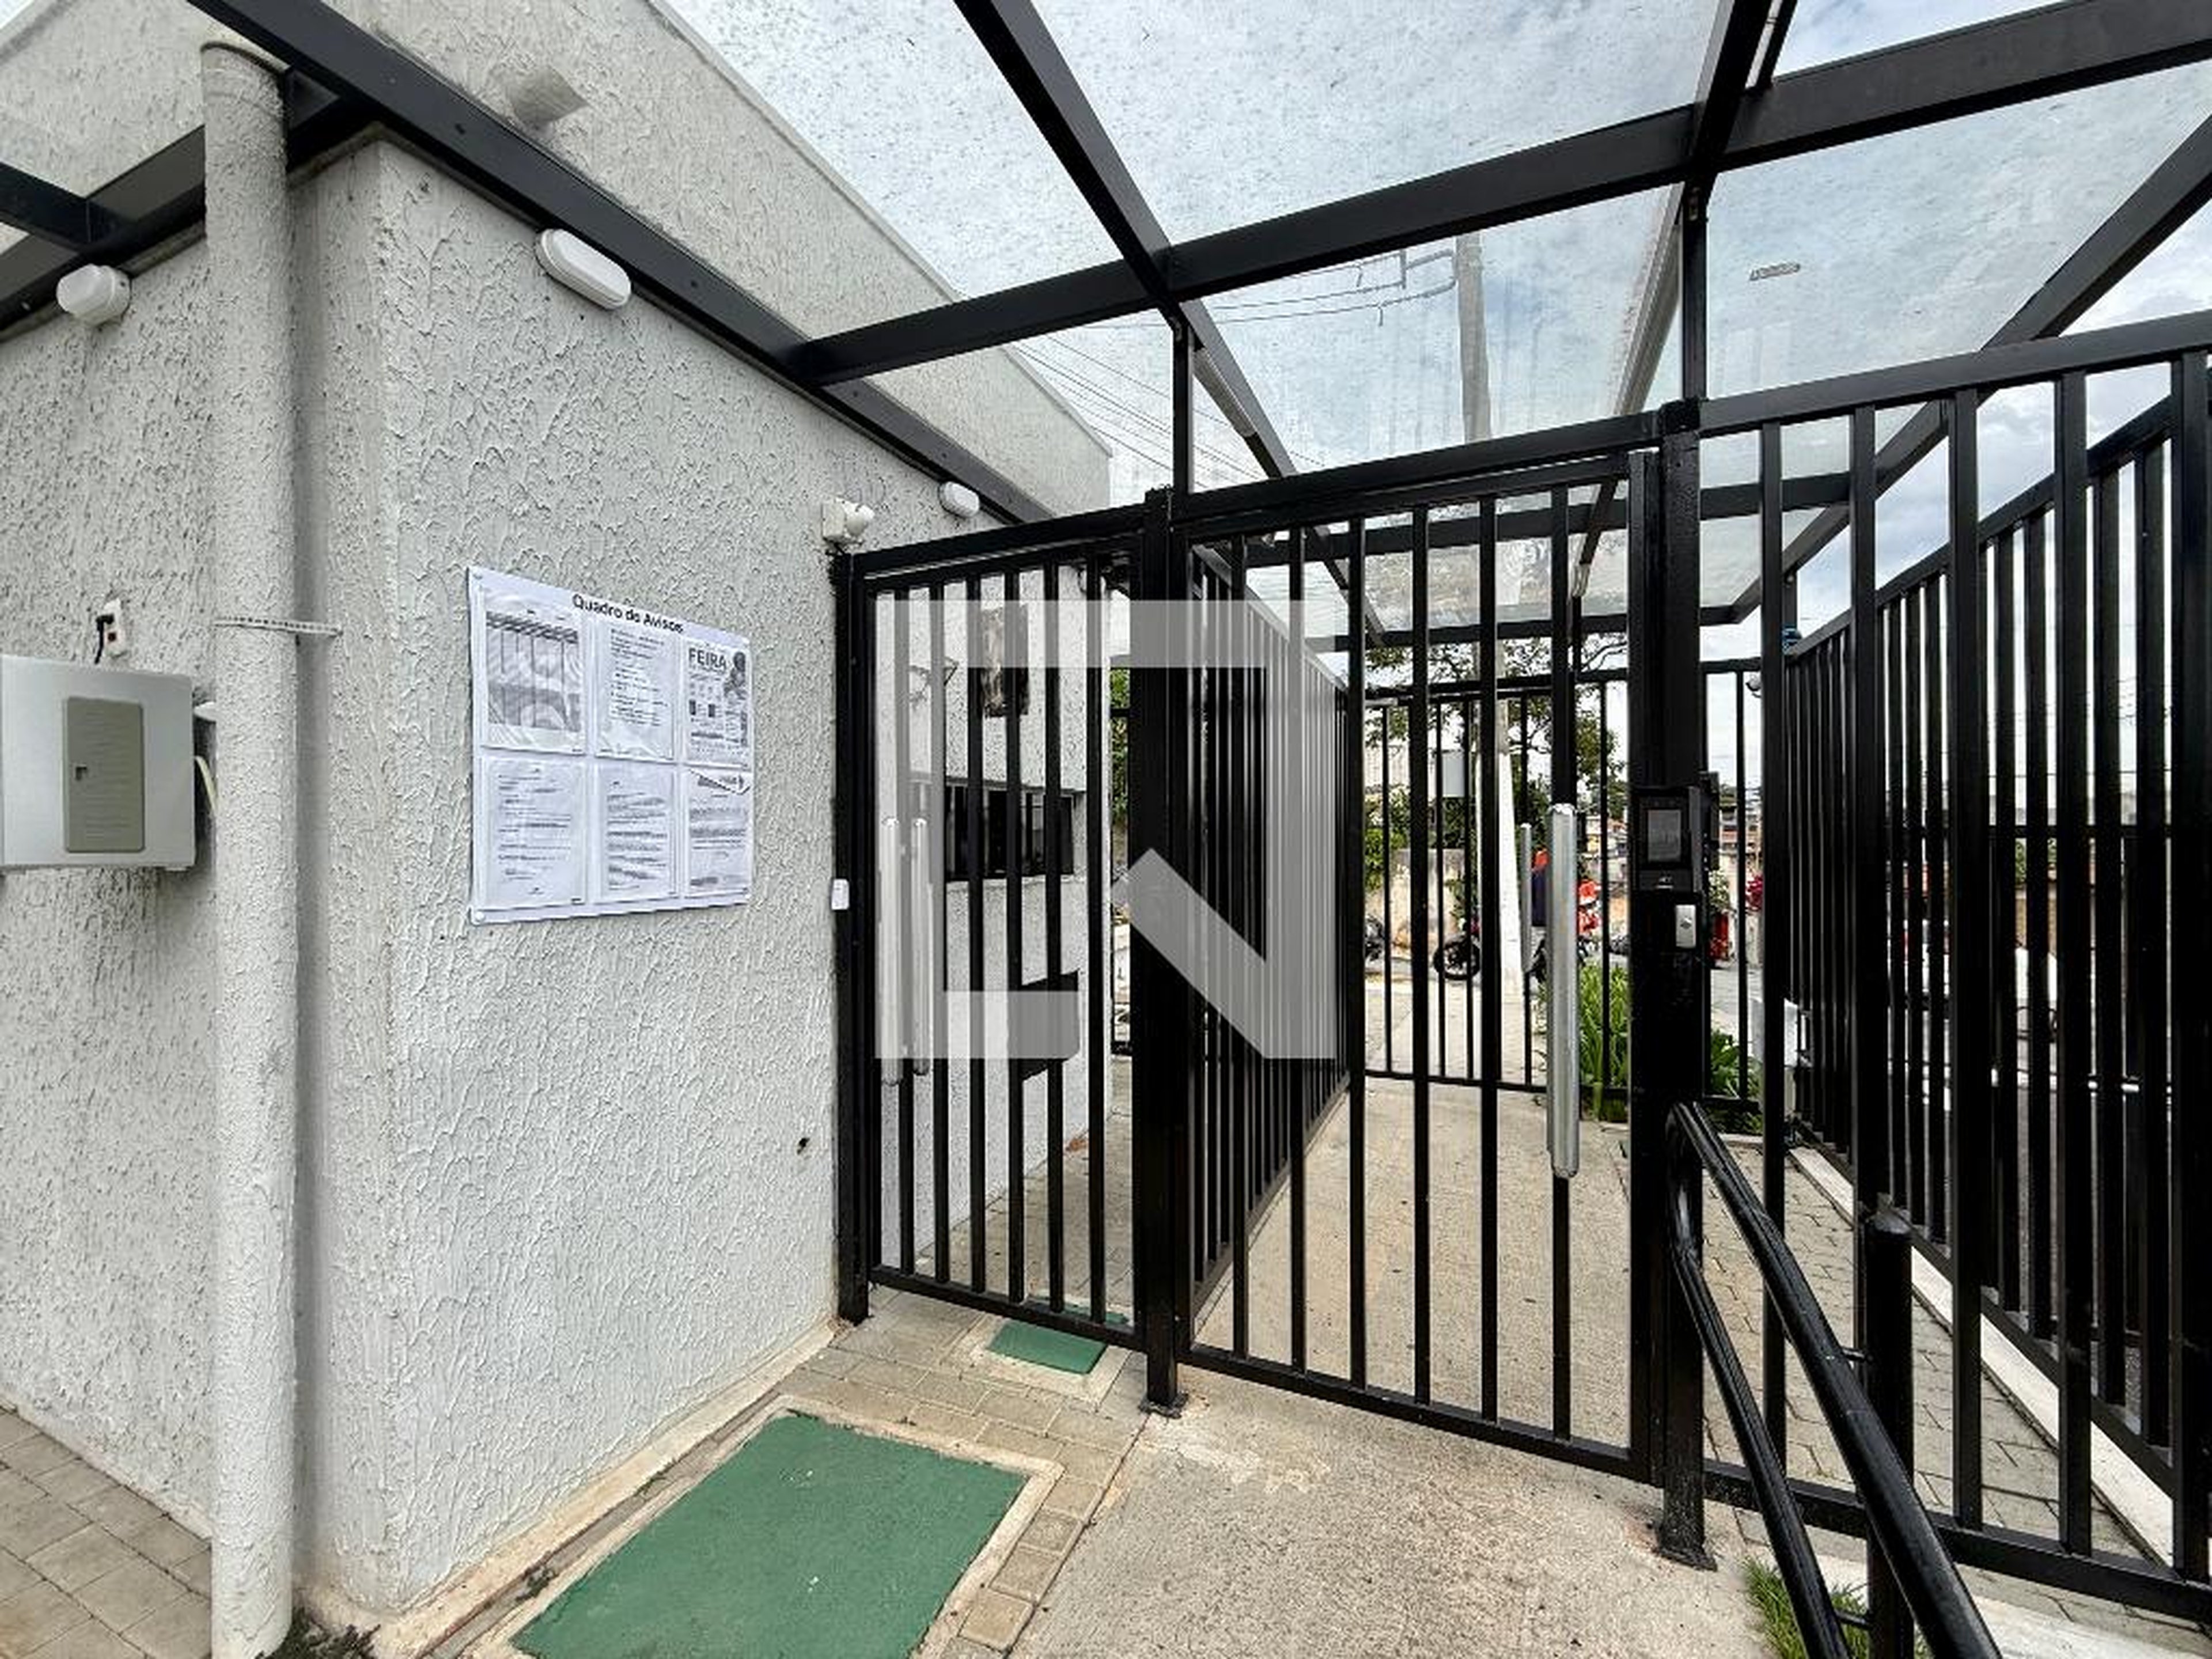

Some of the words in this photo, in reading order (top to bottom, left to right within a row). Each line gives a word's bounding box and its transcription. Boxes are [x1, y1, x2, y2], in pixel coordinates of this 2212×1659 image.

[572, 593, 623, 619] Quadro
[643, 613, 684, 634] Avisos
[688, 647, 726, 669] FEIRA
